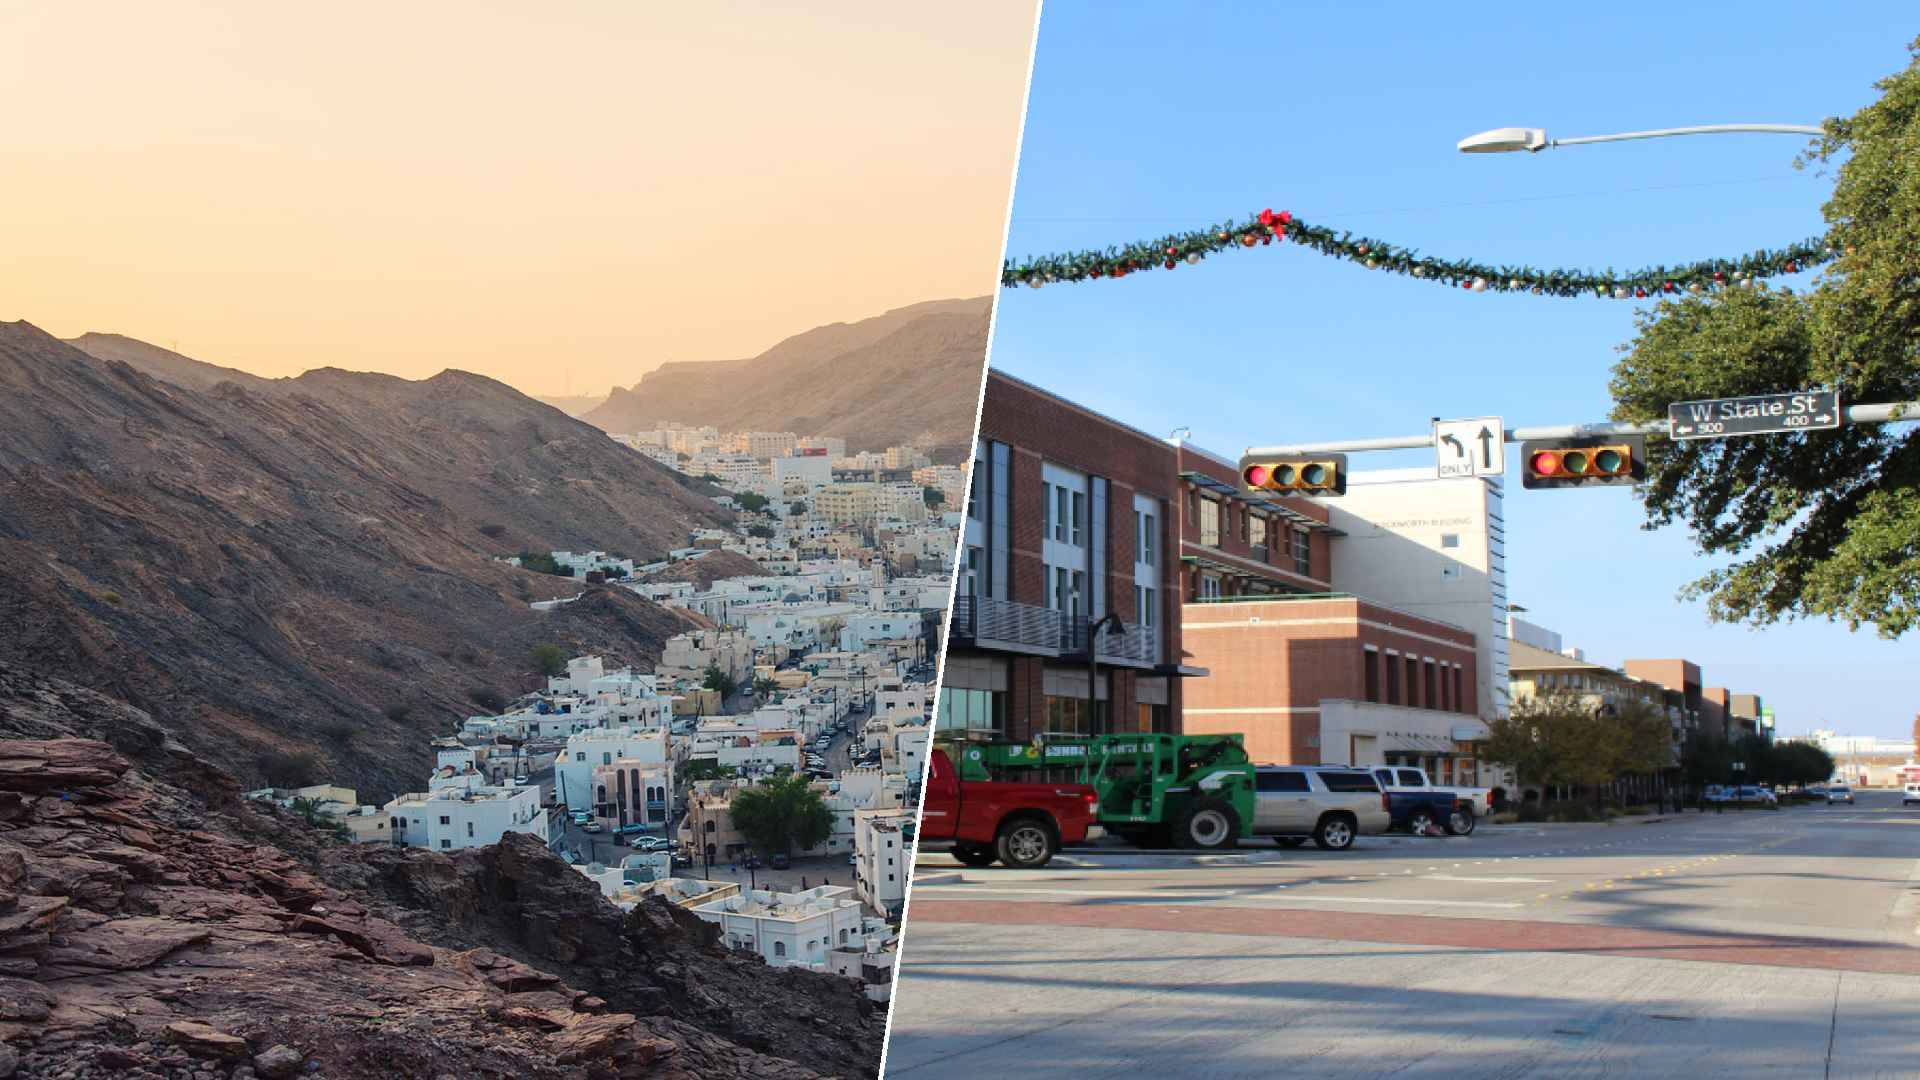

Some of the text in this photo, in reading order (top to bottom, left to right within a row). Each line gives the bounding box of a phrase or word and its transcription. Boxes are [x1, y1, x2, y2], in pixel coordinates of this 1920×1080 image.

[1690, 395, 1817, 421] W State St
[1783, 415, 1810, 426] 400
[1697, 422, 1724, 433] 500
[1440, 463, 1472, 474] ONLY
